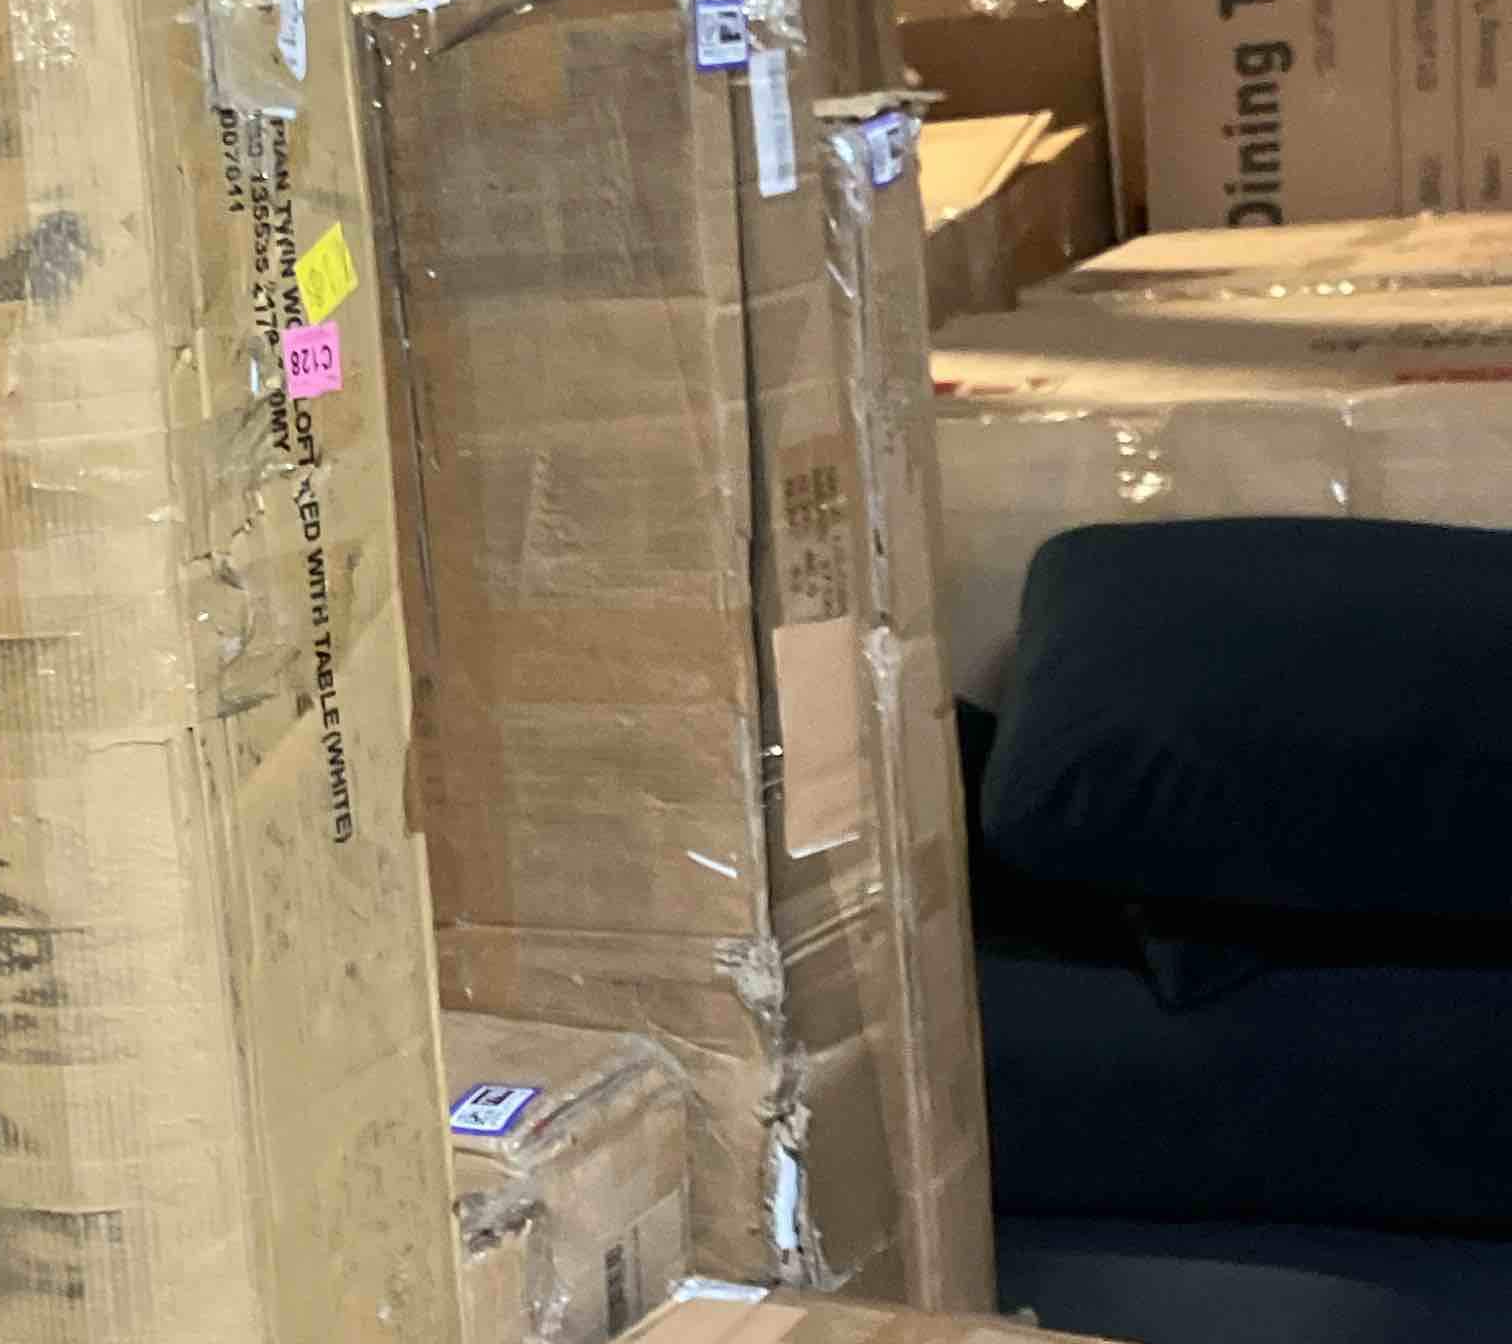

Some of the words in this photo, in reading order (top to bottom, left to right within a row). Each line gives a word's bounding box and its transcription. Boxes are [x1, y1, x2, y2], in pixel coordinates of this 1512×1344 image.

[290, 343, 334, 377] C128
[291, 397, 317, 467] LOFT
[306, 545, 330, 627] WITH
